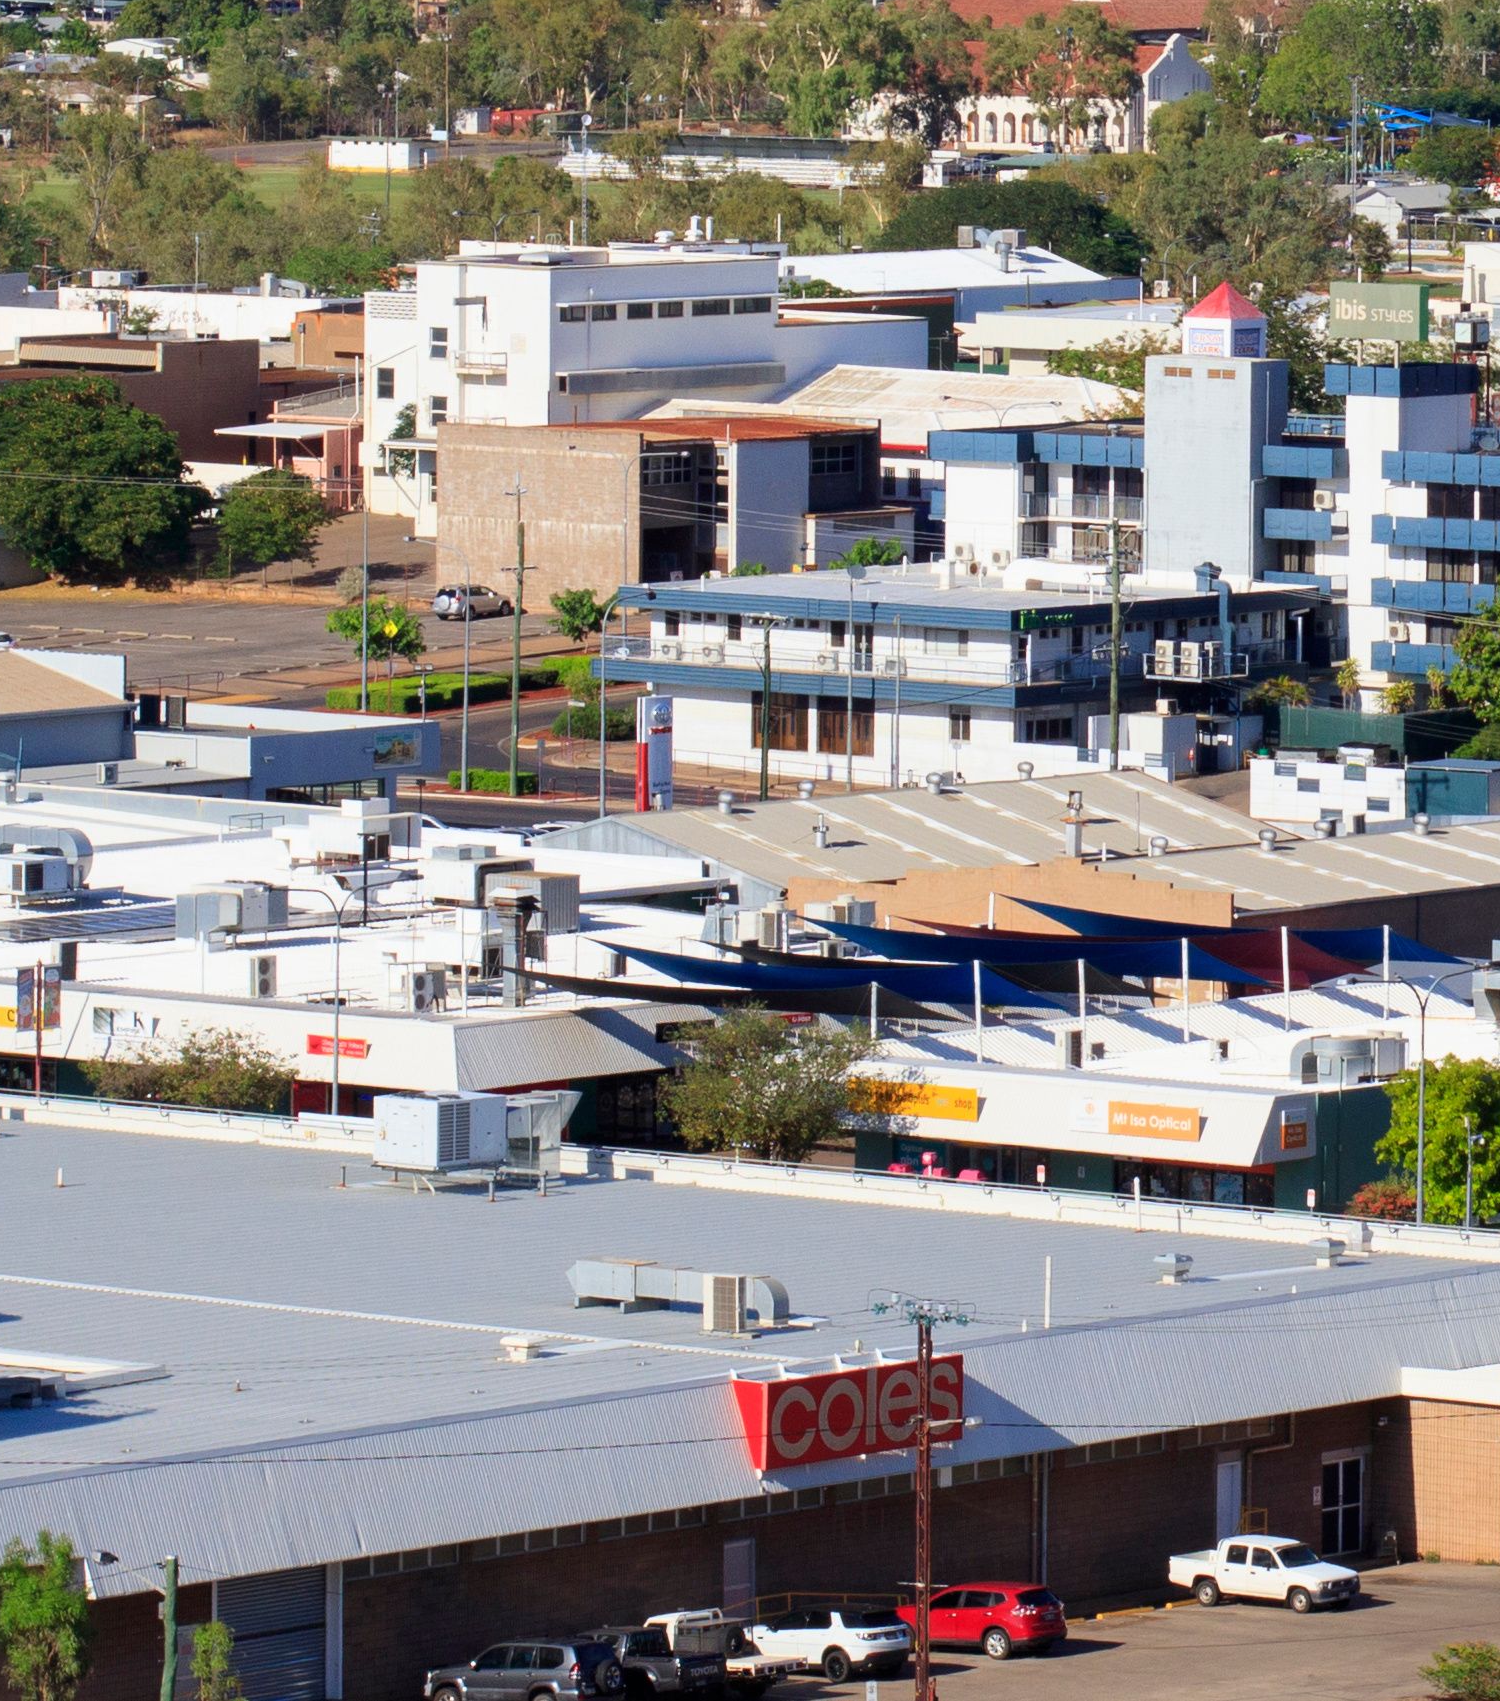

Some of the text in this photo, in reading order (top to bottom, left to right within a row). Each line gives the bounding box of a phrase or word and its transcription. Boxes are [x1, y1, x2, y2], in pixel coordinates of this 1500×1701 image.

[1335, 299, 1367, 320] ibis
[1112, 1111, 1192, 1134] Mt Isa Optical
[771, 1360, 959, 1460] coles
[690, 1665, 719, 1677] TOYOTA
